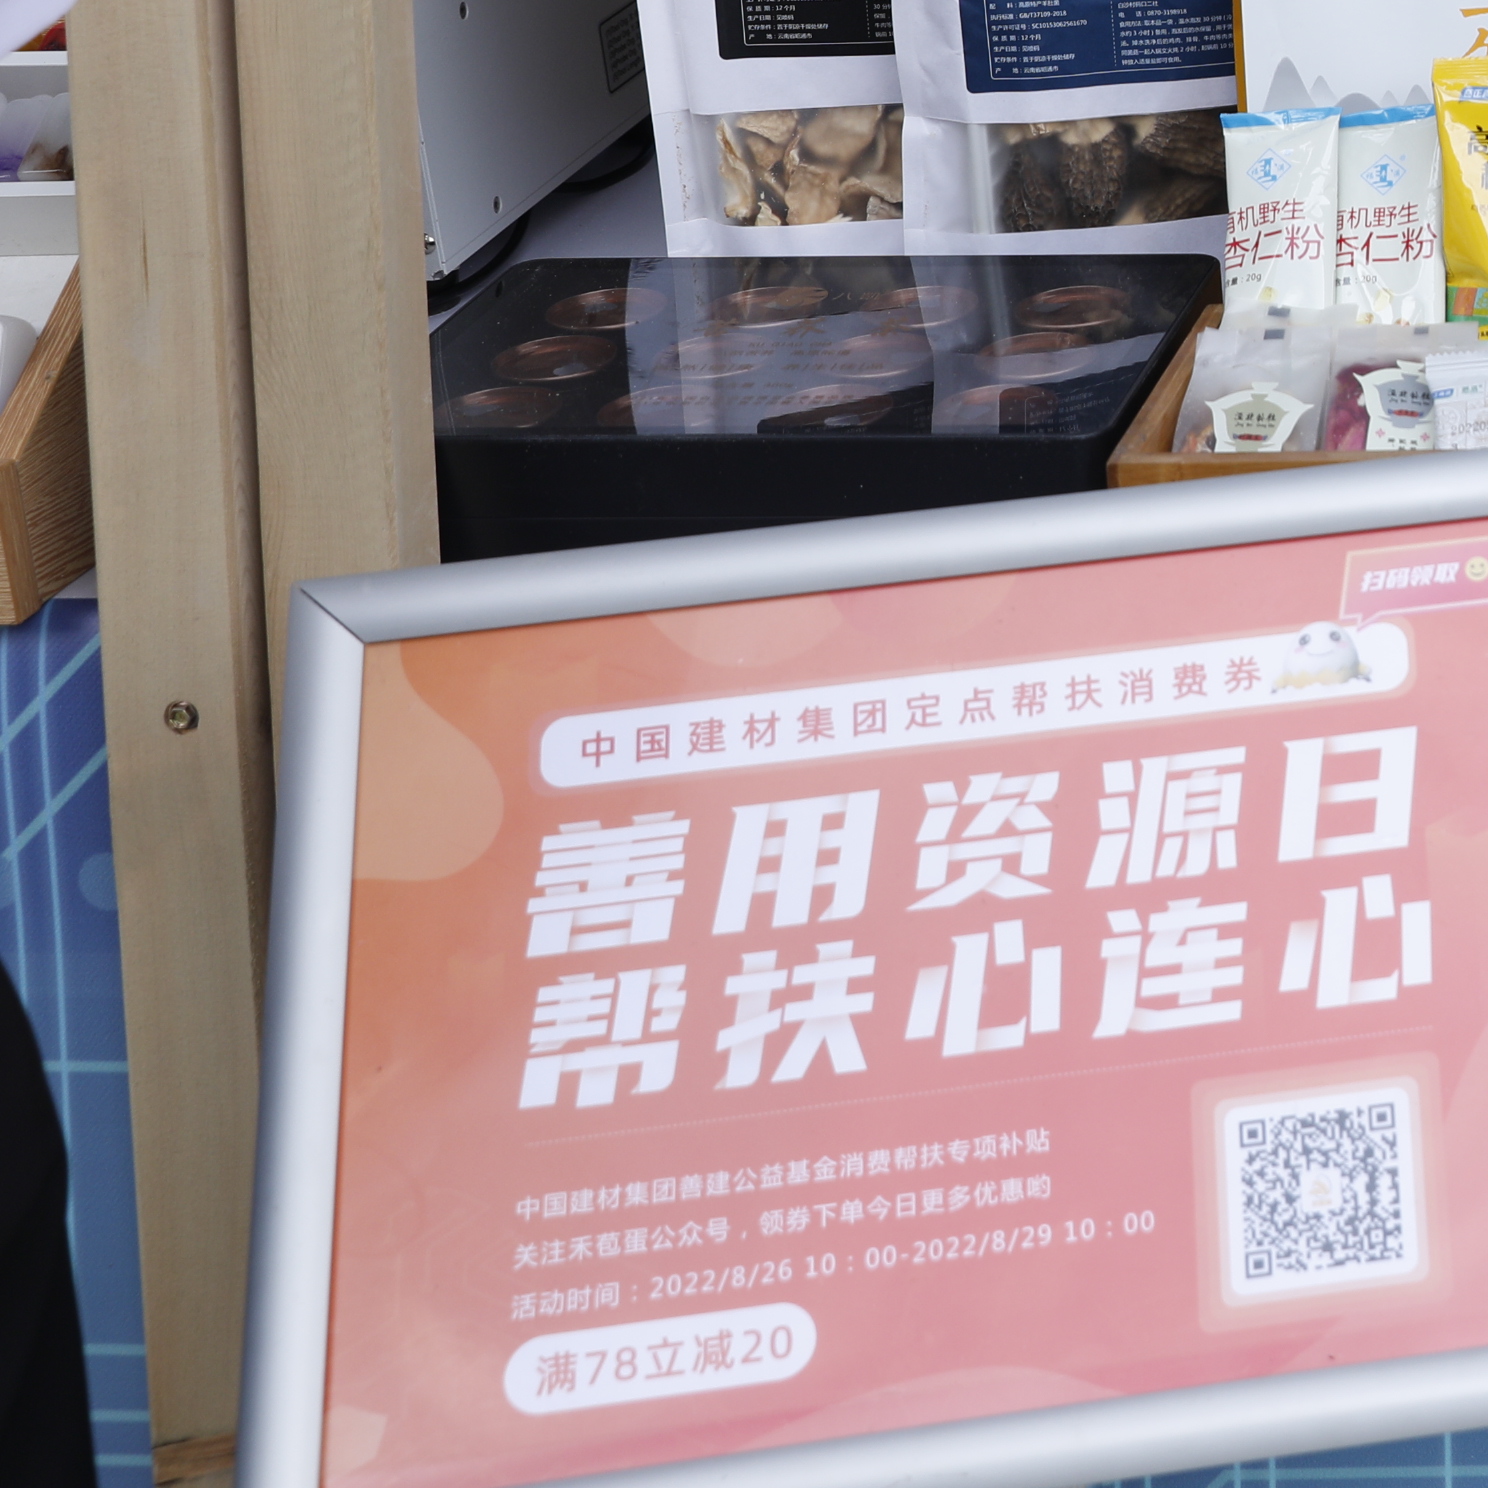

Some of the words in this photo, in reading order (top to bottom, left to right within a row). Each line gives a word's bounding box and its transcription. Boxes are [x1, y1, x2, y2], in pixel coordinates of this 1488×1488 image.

[1224, 223, 1325, 270] 杏仁粉
[1336, 223, 1437, 268] 杏仁粉
[1359, 558, 1459, 592] 扫码领取
[580, 652, 1266, 772] 中国建材集团定点帮扶消费券
[526, 727, 1419, 959] 善用资源日
[518, 872, 1432, 1110] 帮扶心连心
[513, 1174, 1052, 1270] 关注禾苞蛋公众号，领券下单今日更多优惠哟
[516, 1126, 1051, 1223] 中国建材集团善建公益基金消费帮扶专项补贴
[534, 1322, 794, 1398] 满78立减20
